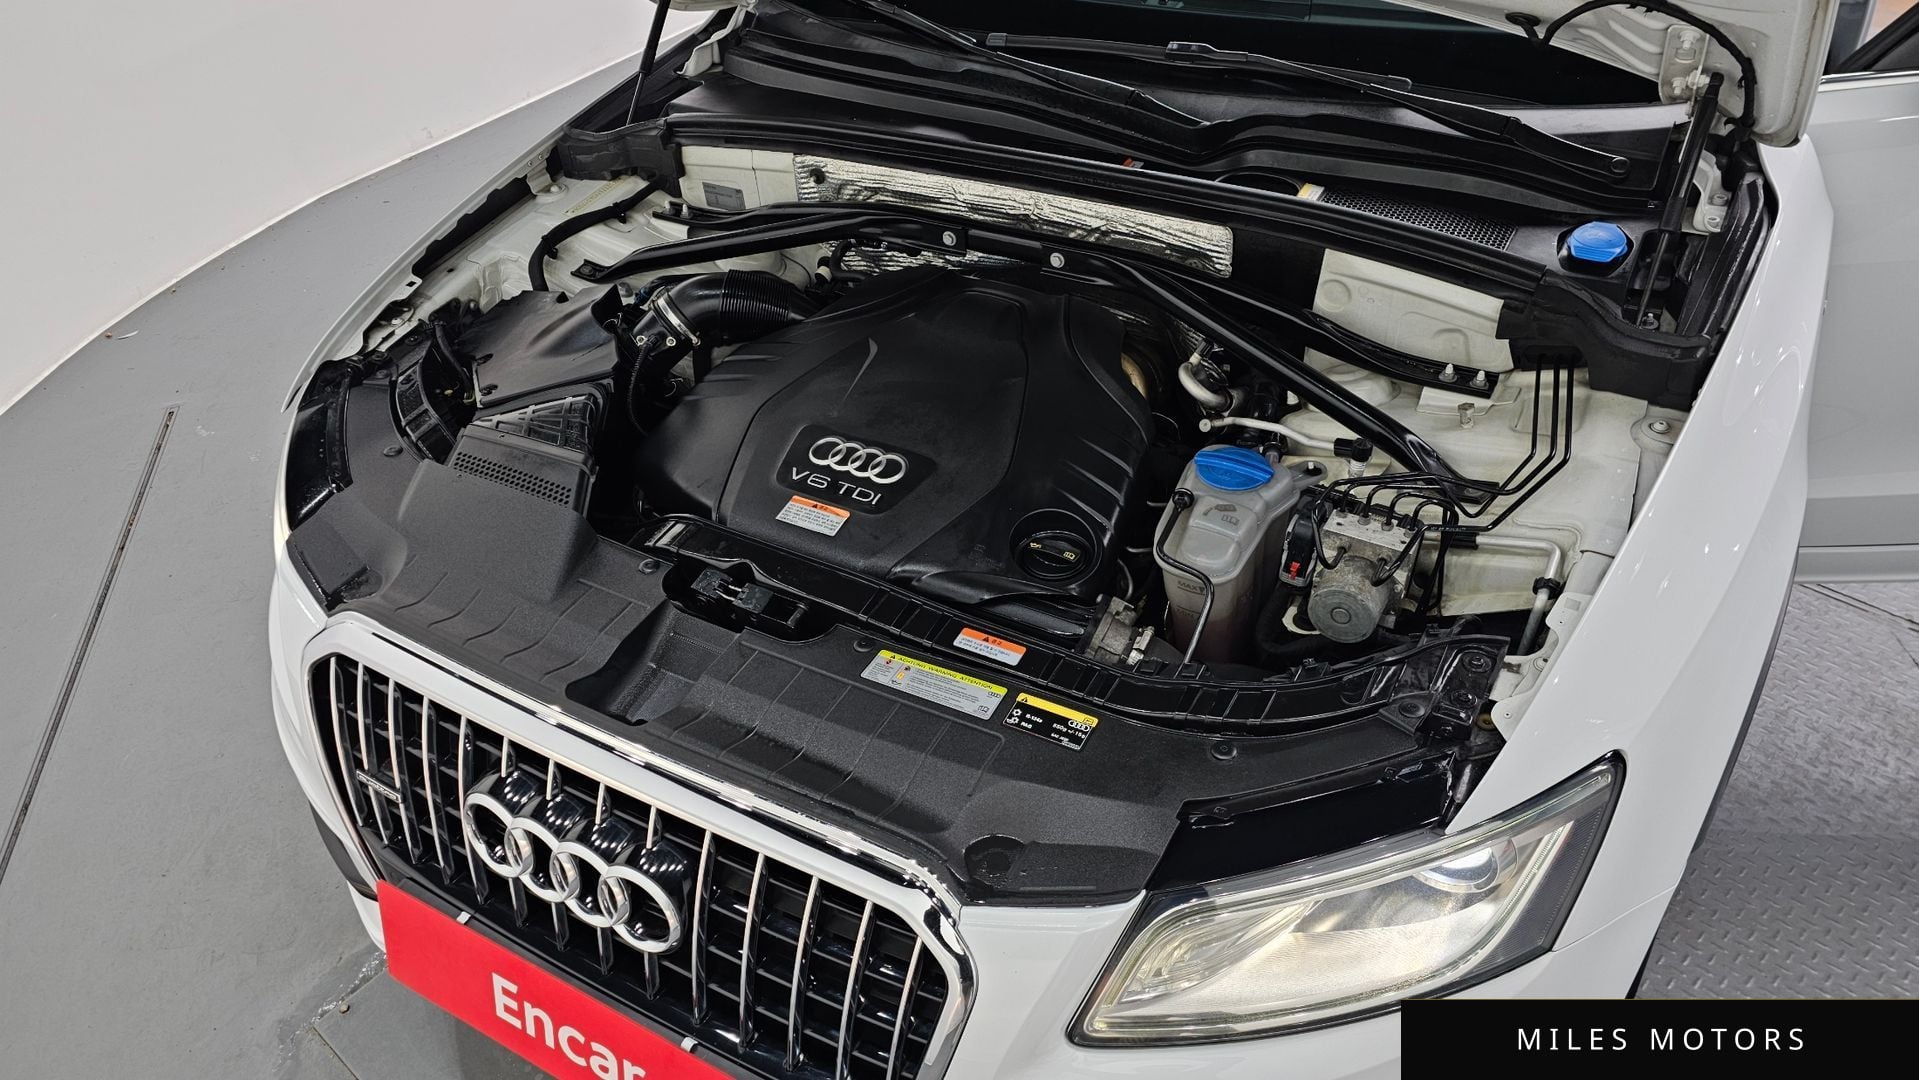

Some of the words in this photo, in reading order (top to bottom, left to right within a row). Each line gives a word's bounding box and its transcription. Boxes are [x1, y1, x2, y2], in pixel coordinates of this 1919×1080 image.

[791, 467, 831, 489] V6
[839, 481, 882, 505] TDI
[928, 666, 957, 678] WARNING
[959, 675, 993, 690] ATTENTION
[491, 972, 646, 1080] Encar
